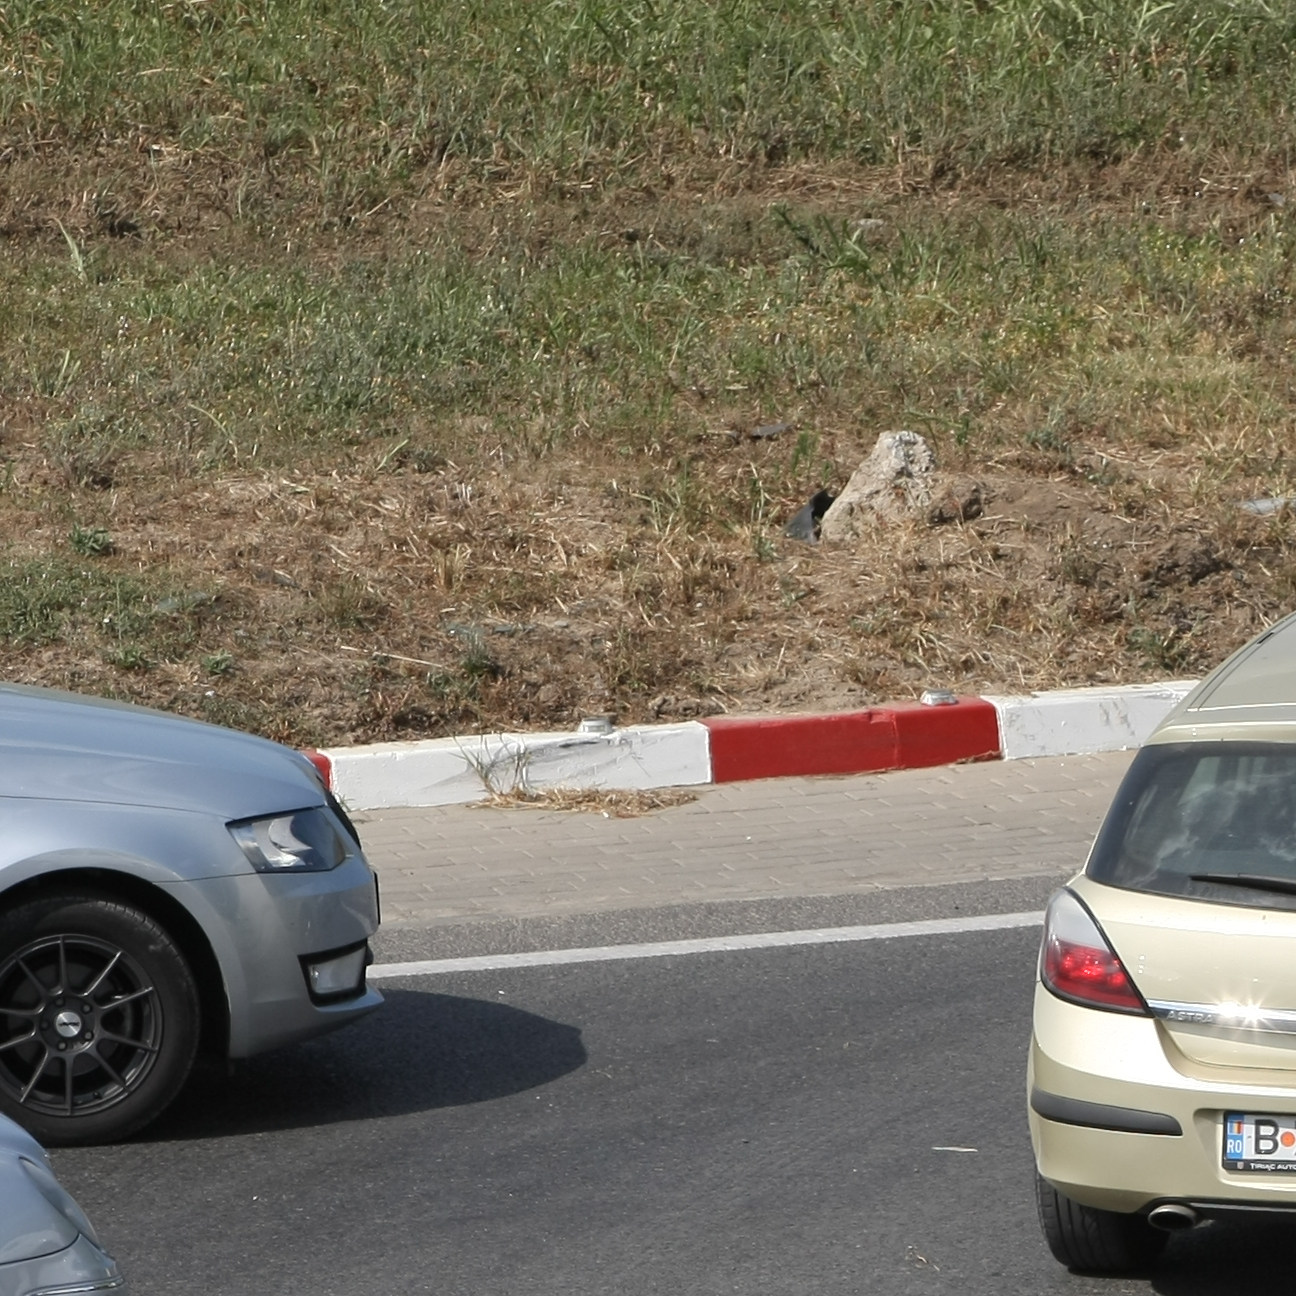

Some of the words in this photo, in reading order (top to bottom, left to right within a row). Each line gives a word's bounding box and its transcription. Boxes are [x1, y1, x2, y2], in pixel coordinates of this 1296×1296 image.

[1165, 1010, 1214, 1023] ASTRA
[1254, 1118, 1280, 1156] B
[1226, 1138, 1243, 1154] RO
